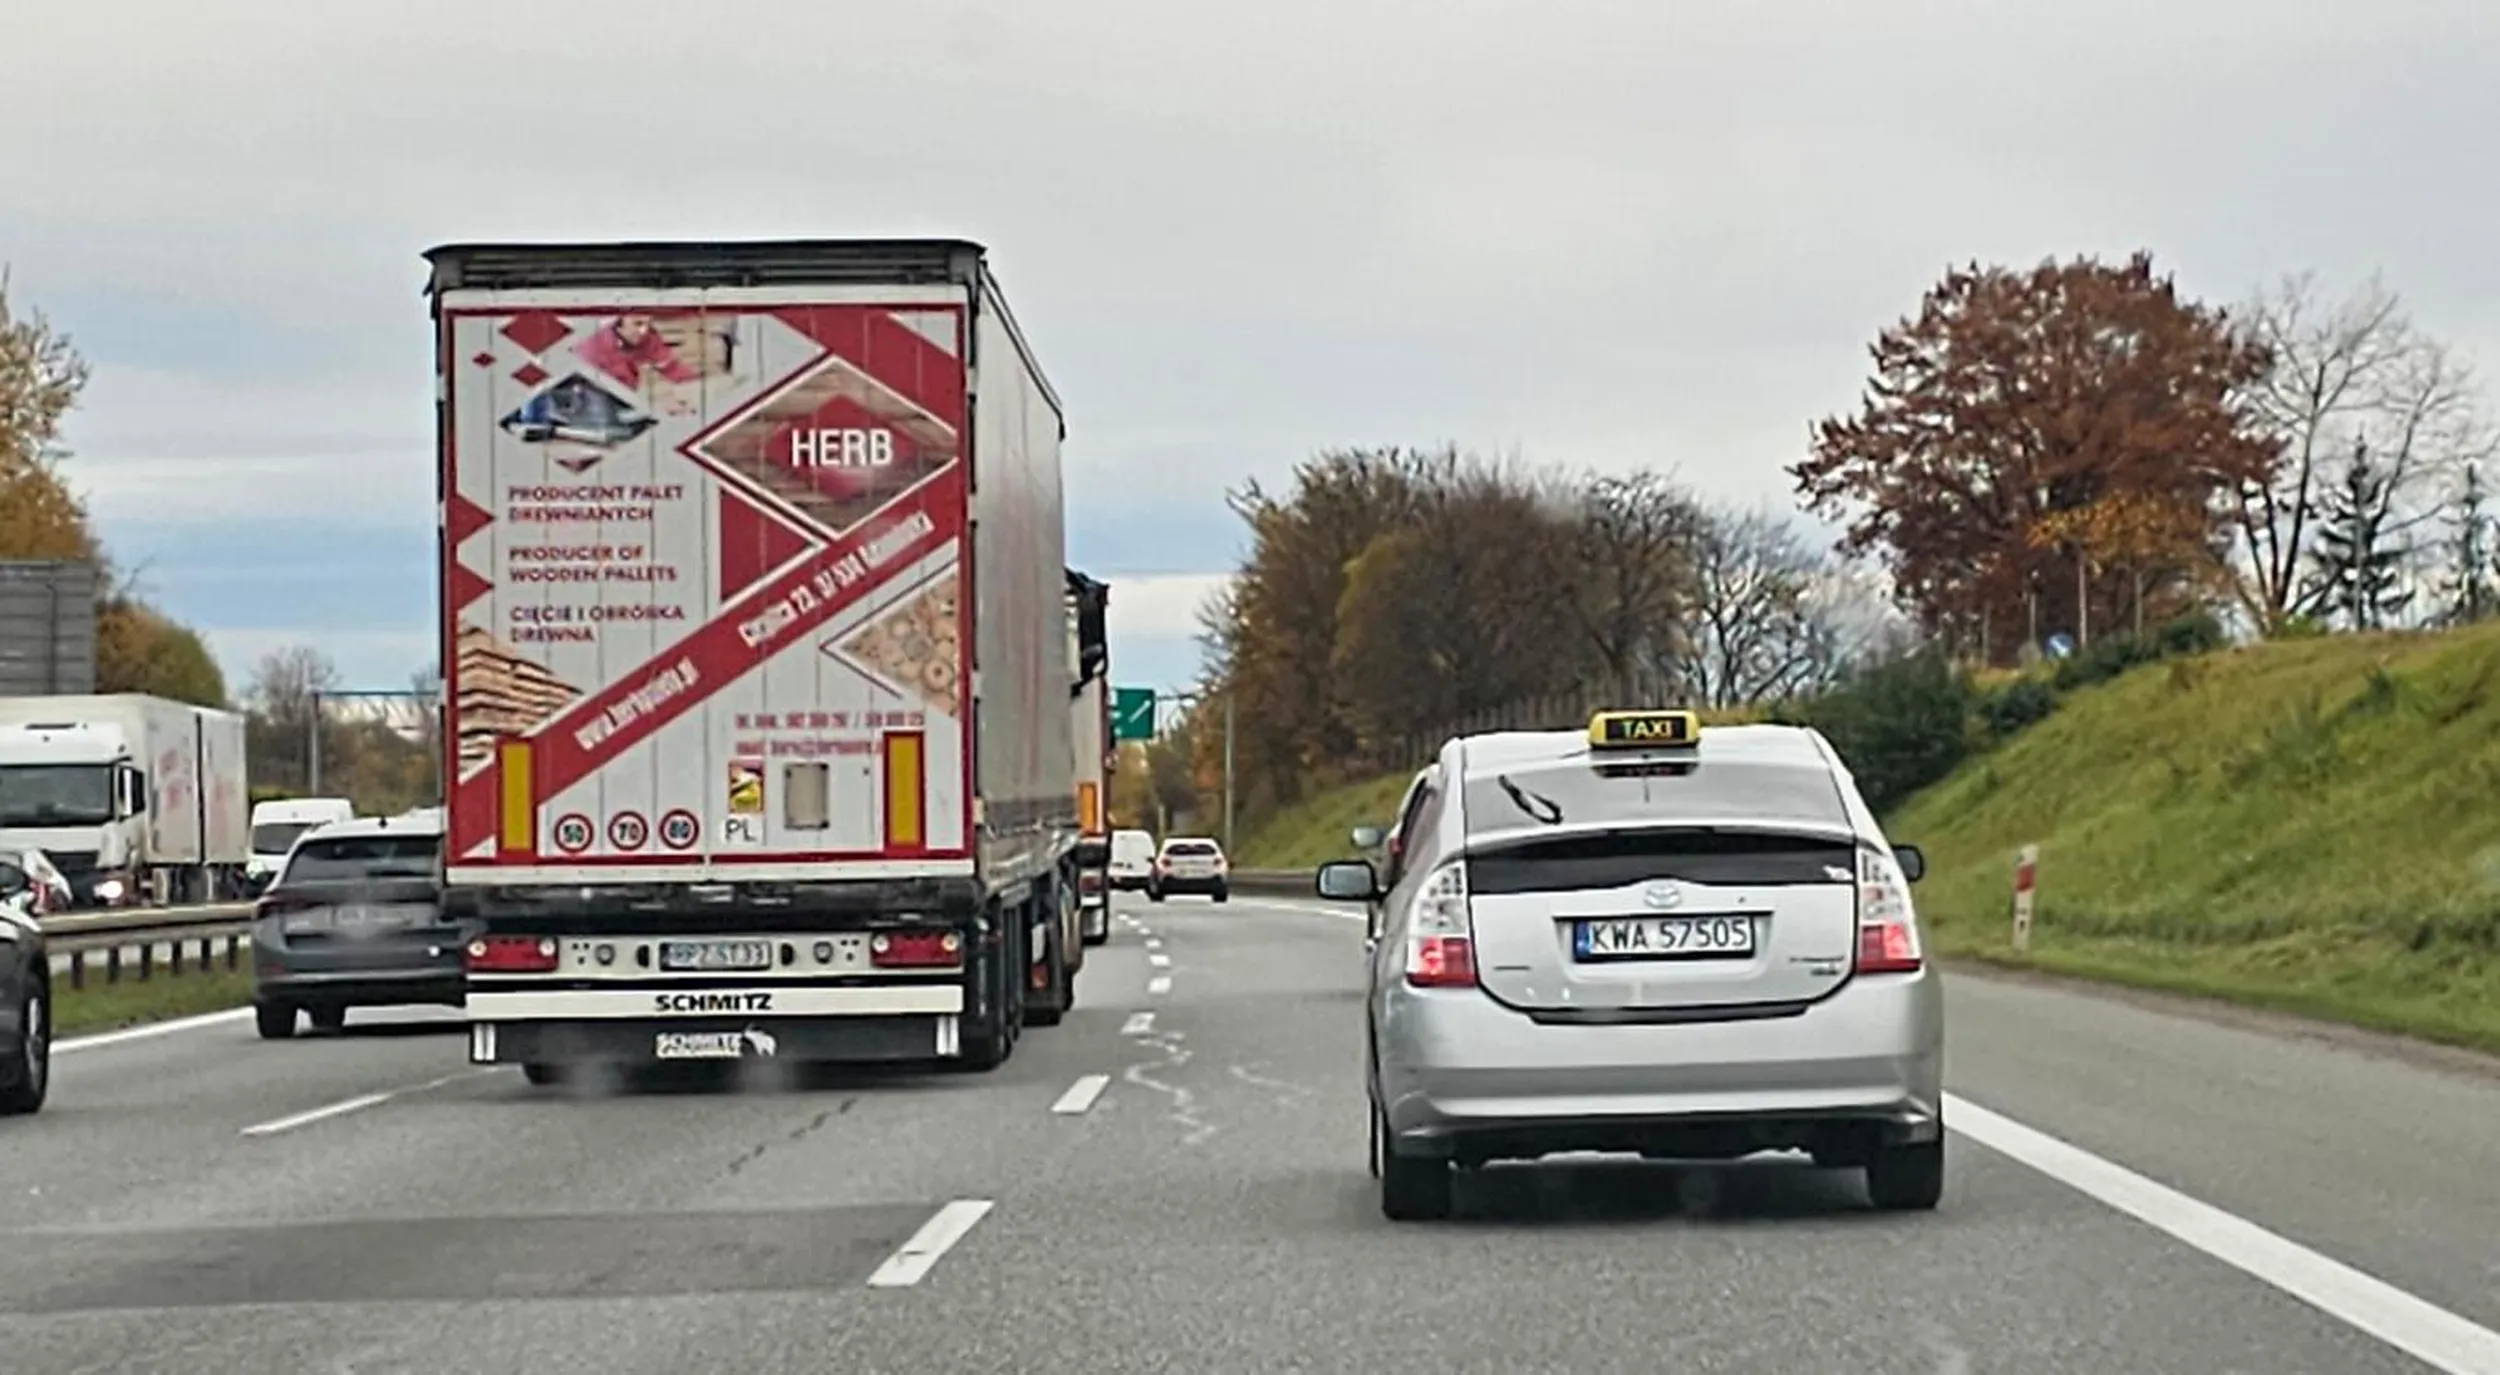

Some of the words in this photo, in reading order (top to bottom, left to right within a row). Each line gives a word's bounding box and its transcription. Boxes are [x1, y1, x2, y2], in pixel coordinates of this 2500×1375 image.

[792, 428, 893, 467] HERB
[508, 486, 625, 501] PRODUCENT
[631, 485, 683, 500] PALET
[509, 545, 613, 561] PRODUCER
[618, 545, 643, 561] OF
[509, 567, 598, 582] WOODEN
[604, 566, 677, 582] PALLETS
[510, 627, 595, 643] DREWNA
[1621, 720, 1674, 739] TAXI
[561, 823, 586, 843] 50
[617, 821, 641, 842] 70
[724, 818, 757, 843] PL
[1593, 921, 1650, 951] KWA
[1659, 918, 1749, 949] 57505
[655, 993, 773, 1012] SCHMITZ
